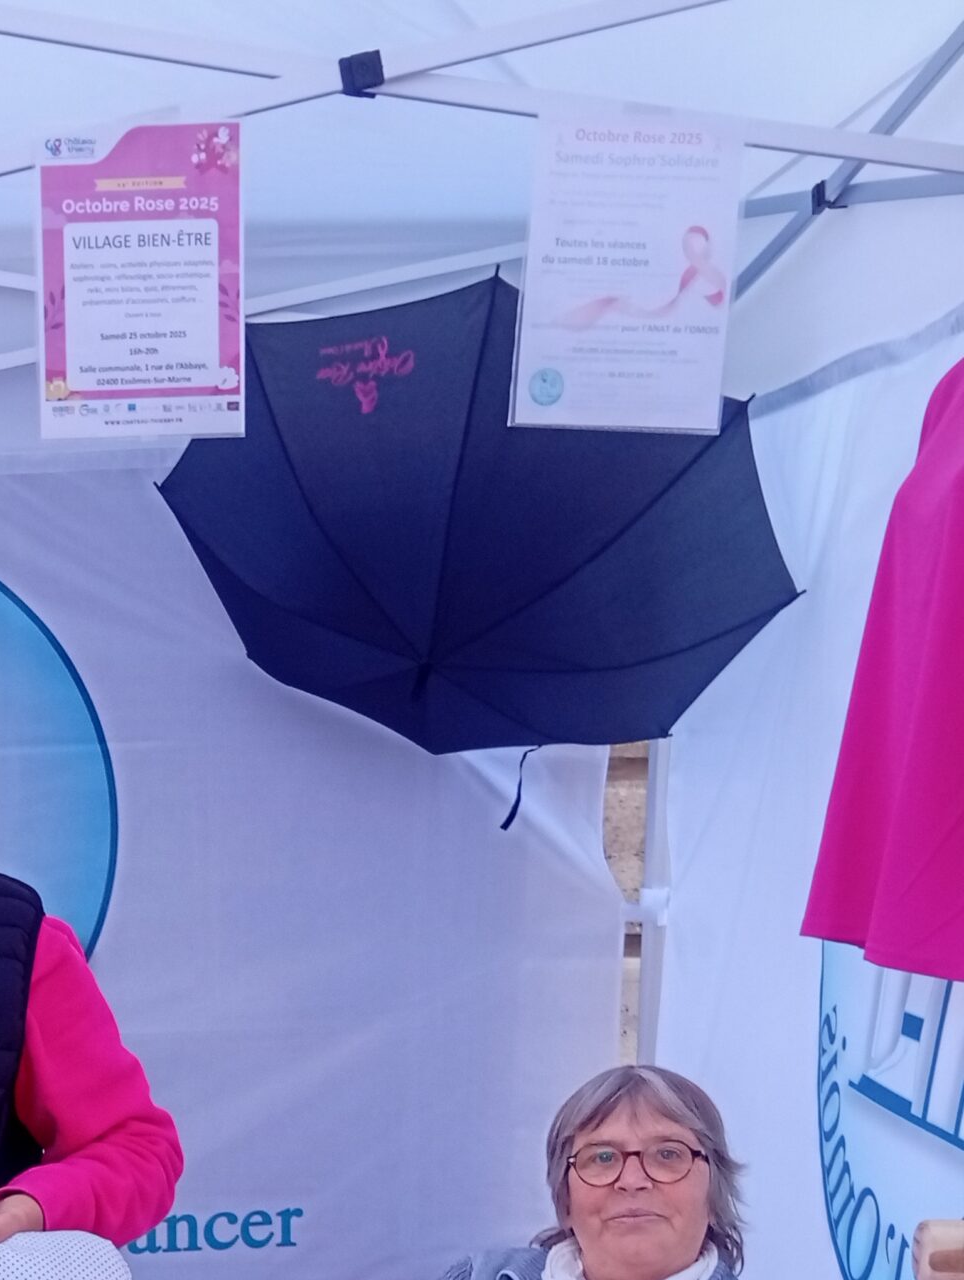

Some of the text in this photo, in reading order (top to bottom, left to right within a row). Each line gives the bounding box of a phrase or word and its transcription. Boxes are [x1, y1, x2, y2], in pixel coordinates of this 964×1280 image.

[575, 128, 703, 145] Octobre Rose 2025
[555, 150, 604, 166] Samedi
[62, 197, 219, 214] Octobre Rose 2025
[72, 230, 212, 250] VILLAGE BIEN-ÊTRE
[554, 237, 647, 251] Toutes les séances
[557, 254, 594, 266] samedi
[610, 257, 650, 268] octobre
[100, 332, 127, 341] Samedi
[139, 332, 167, 340] octobre
[79, 366, 97, 374] Salle
[98, 365, 143, 374] communale,
[96, 378, 119, 386] 02400
